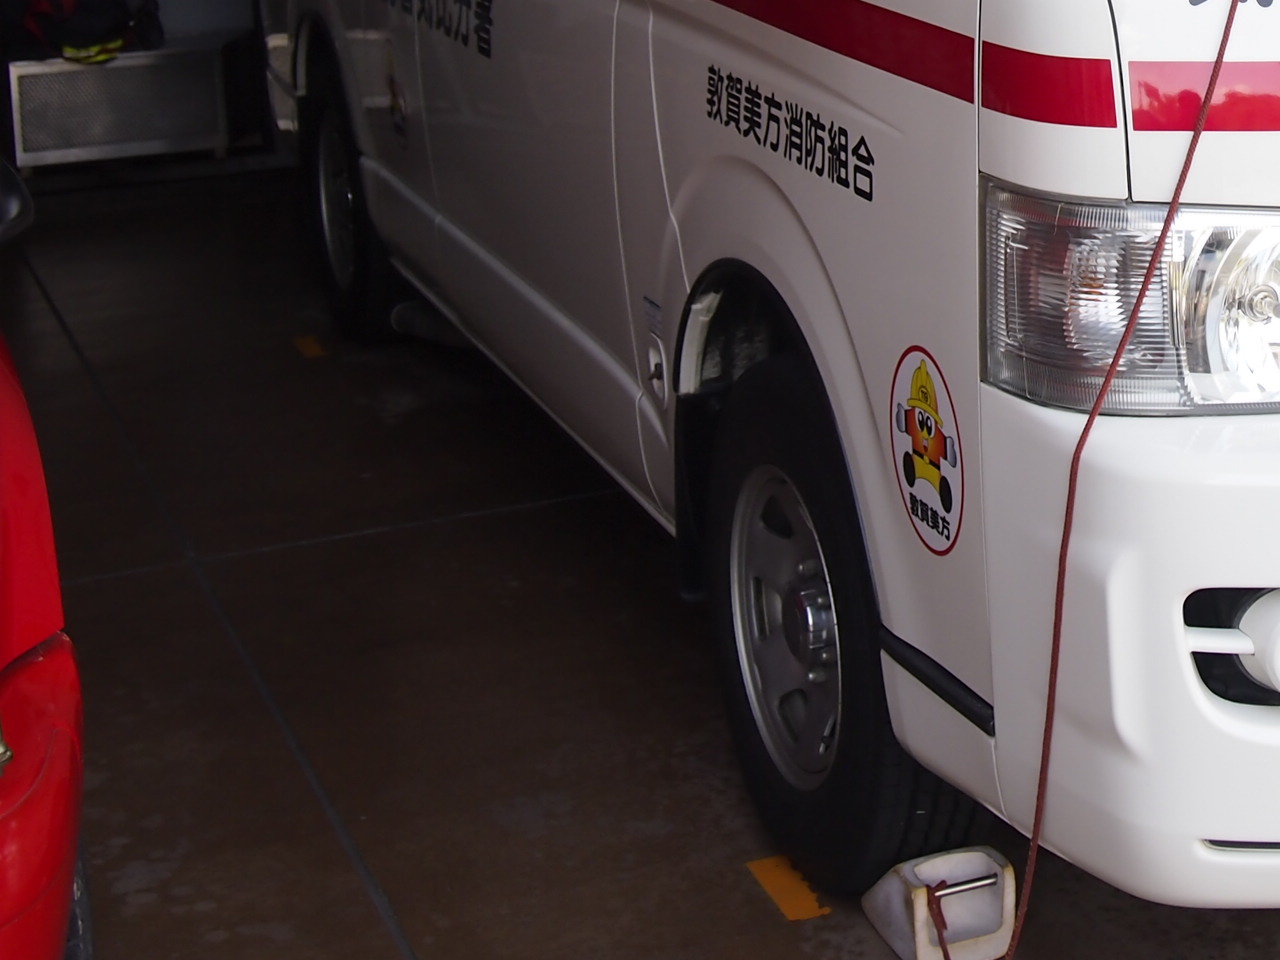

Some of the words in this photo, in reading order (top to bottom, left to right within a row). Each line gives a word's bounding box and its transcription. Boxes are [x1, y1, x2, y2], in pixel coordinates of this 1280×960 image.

[706, 65, 875, 202] 敦賀美方消防組合
[909, 492, 951, 542] 敦賀美方
